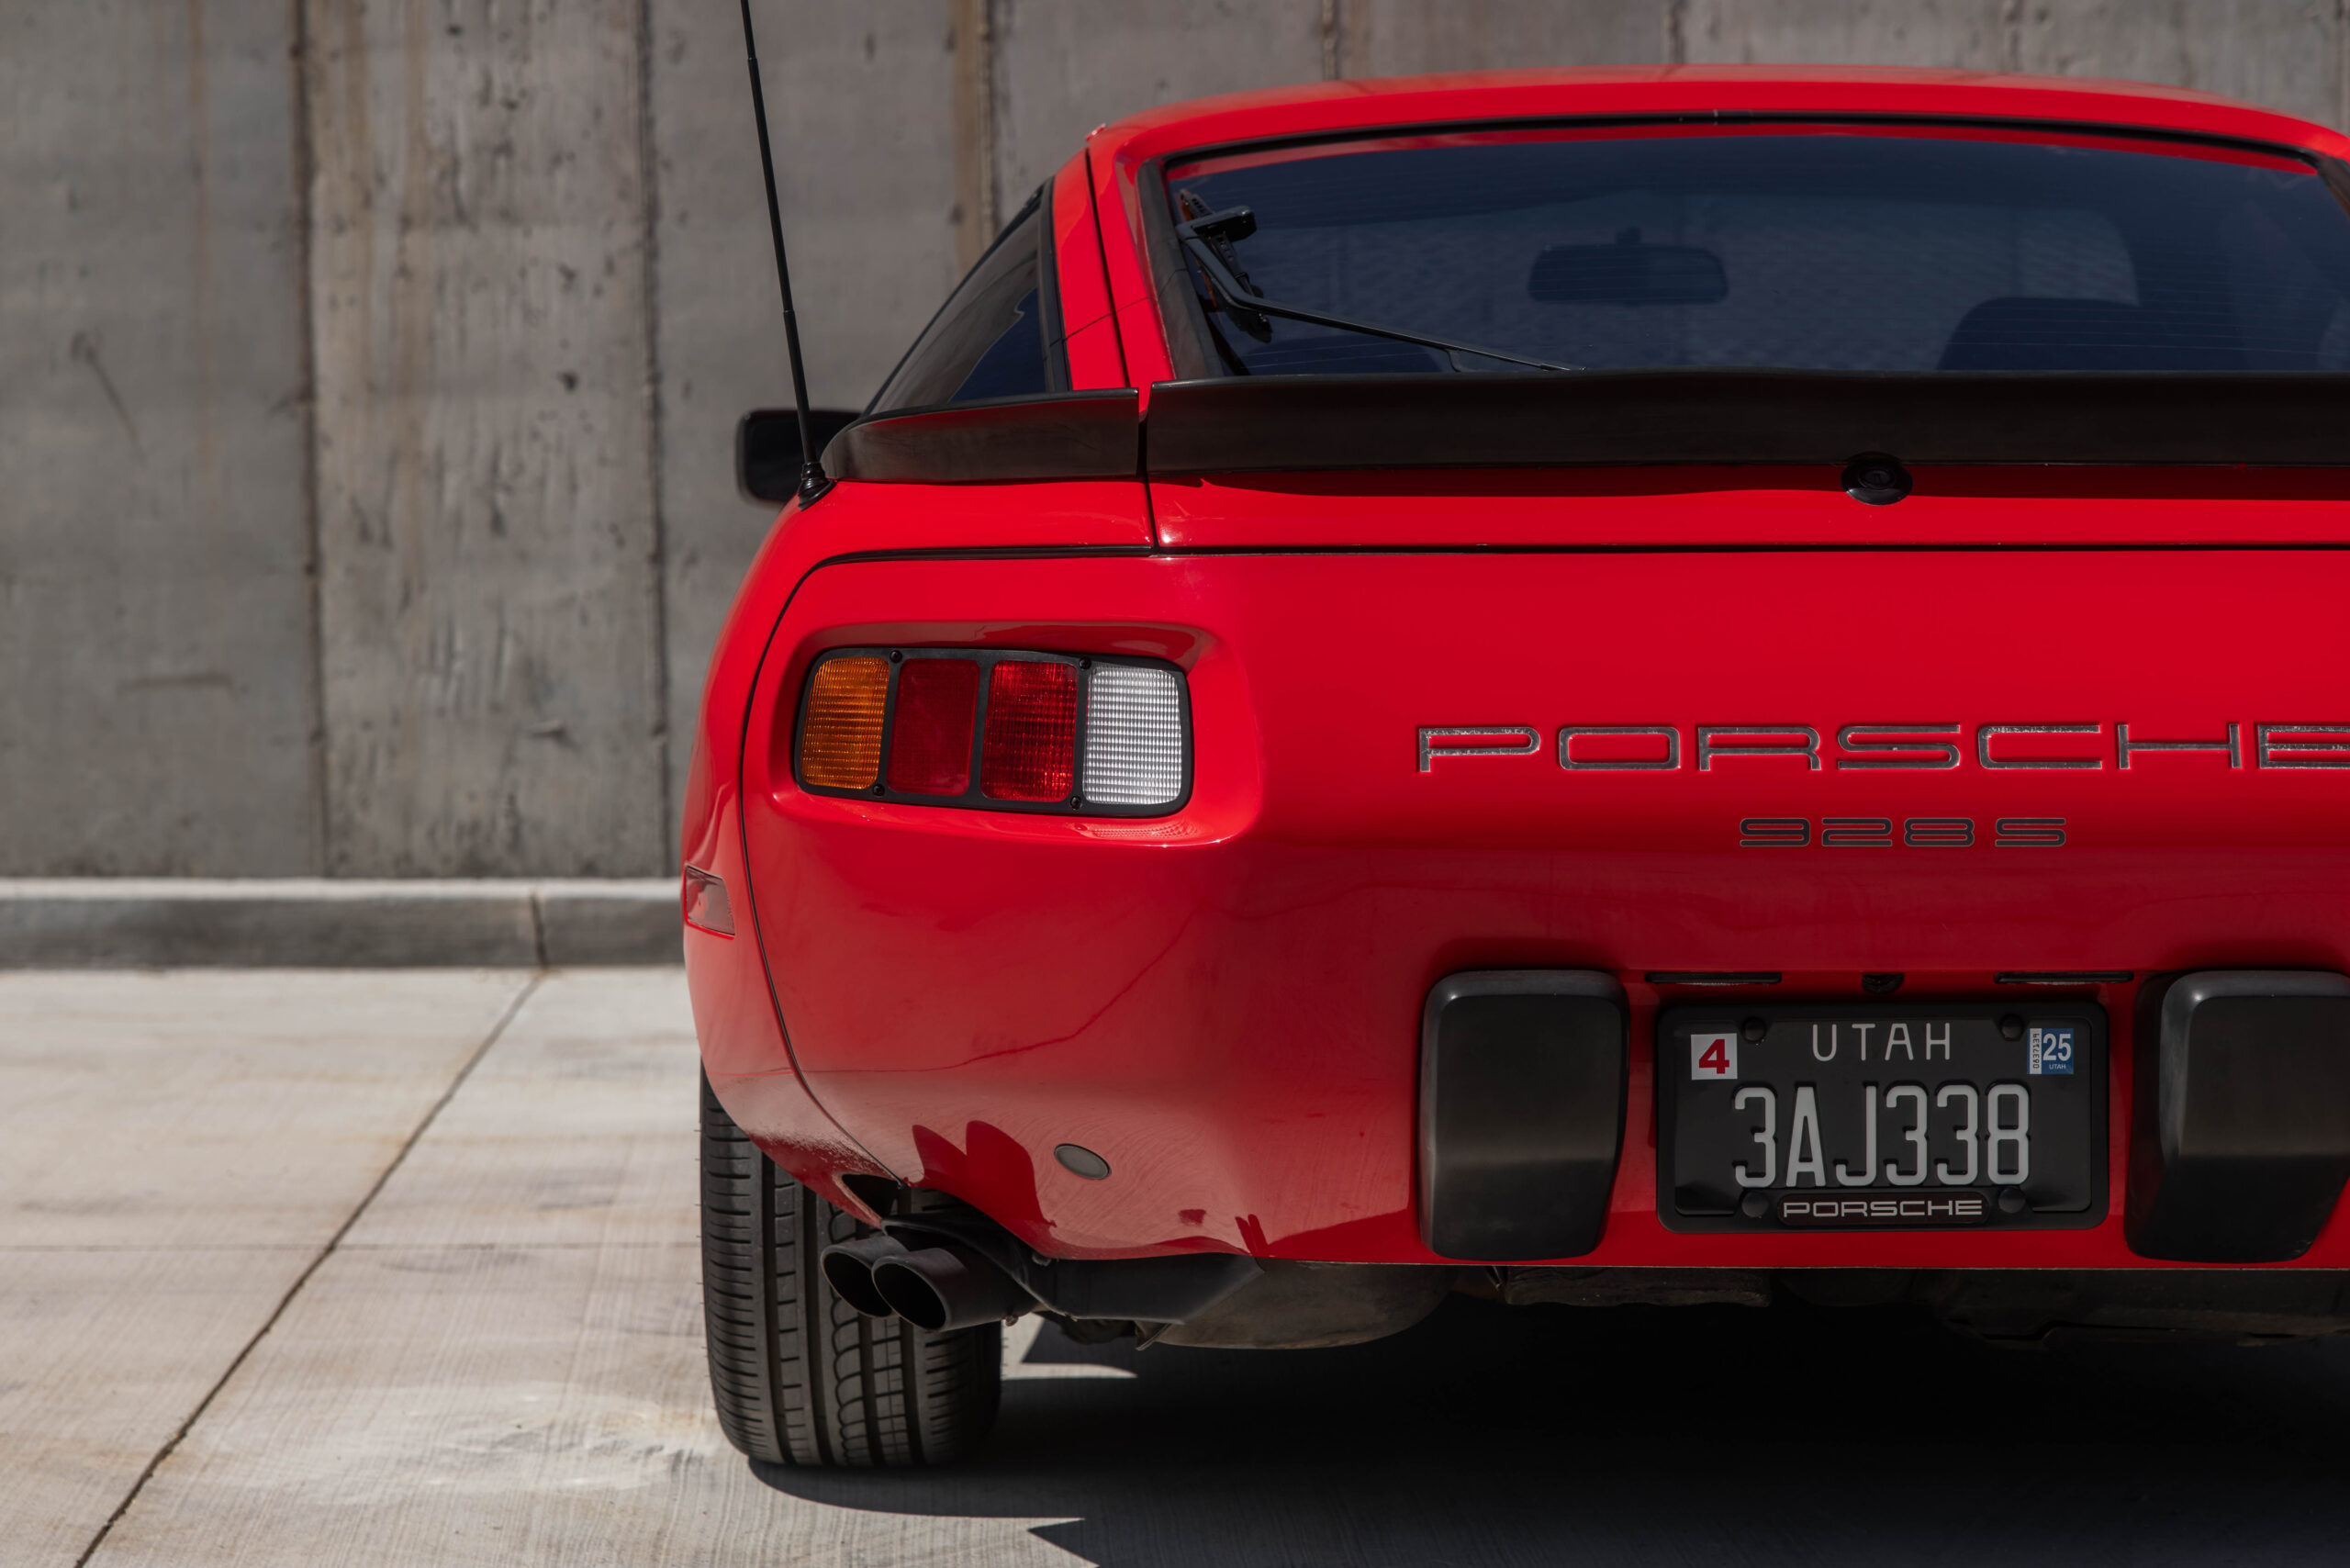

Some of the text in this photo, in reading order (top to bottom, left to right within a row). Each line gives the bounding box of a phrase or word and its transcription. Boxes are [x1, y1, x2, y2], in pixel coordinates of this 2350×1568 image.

[1418, 722, 2350, 772] PORSCHE
[1698, 1038, 1730, 1074] 4
[1812, 1023, 1951, 1062] UTAH
[2042, 1033, 2072, 1062] 25
[1734, 1084, 2030, 1189] 3AJ338
[1783, 1199, 1983, 1218] PORSCHE
